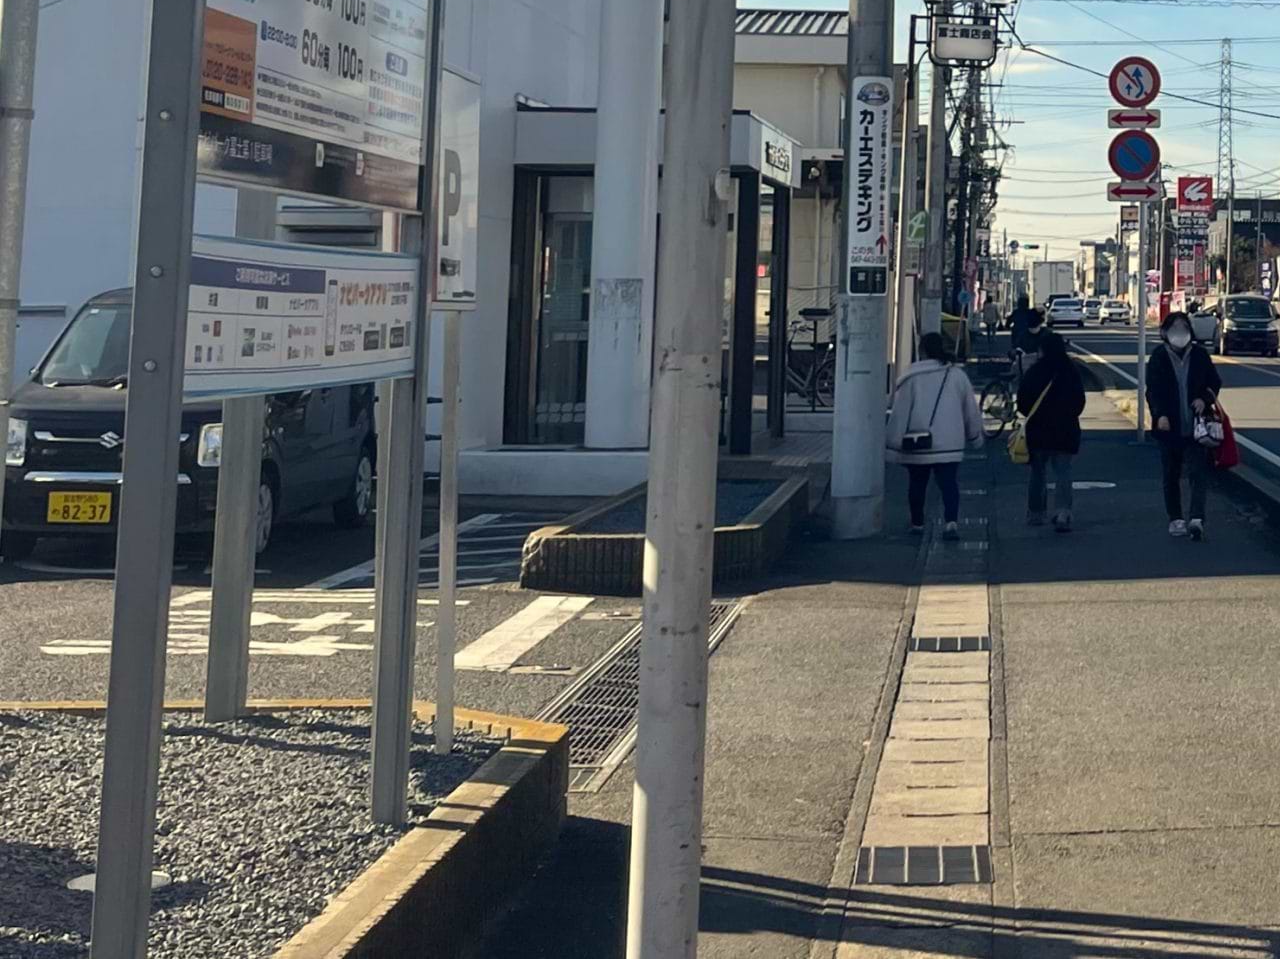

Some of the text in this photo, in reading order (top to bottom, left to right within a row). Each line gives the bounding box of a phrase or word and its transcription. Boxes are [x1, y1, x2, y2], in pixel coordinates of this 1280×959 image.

[938, 27, 992, 39] 富士商店会
[337, 41, 364, 84] 100円
[856, 108, 875, 234] カーエステキング
[442, 148, 461, 246] P
[62, 504, 107, 520] 82-37
